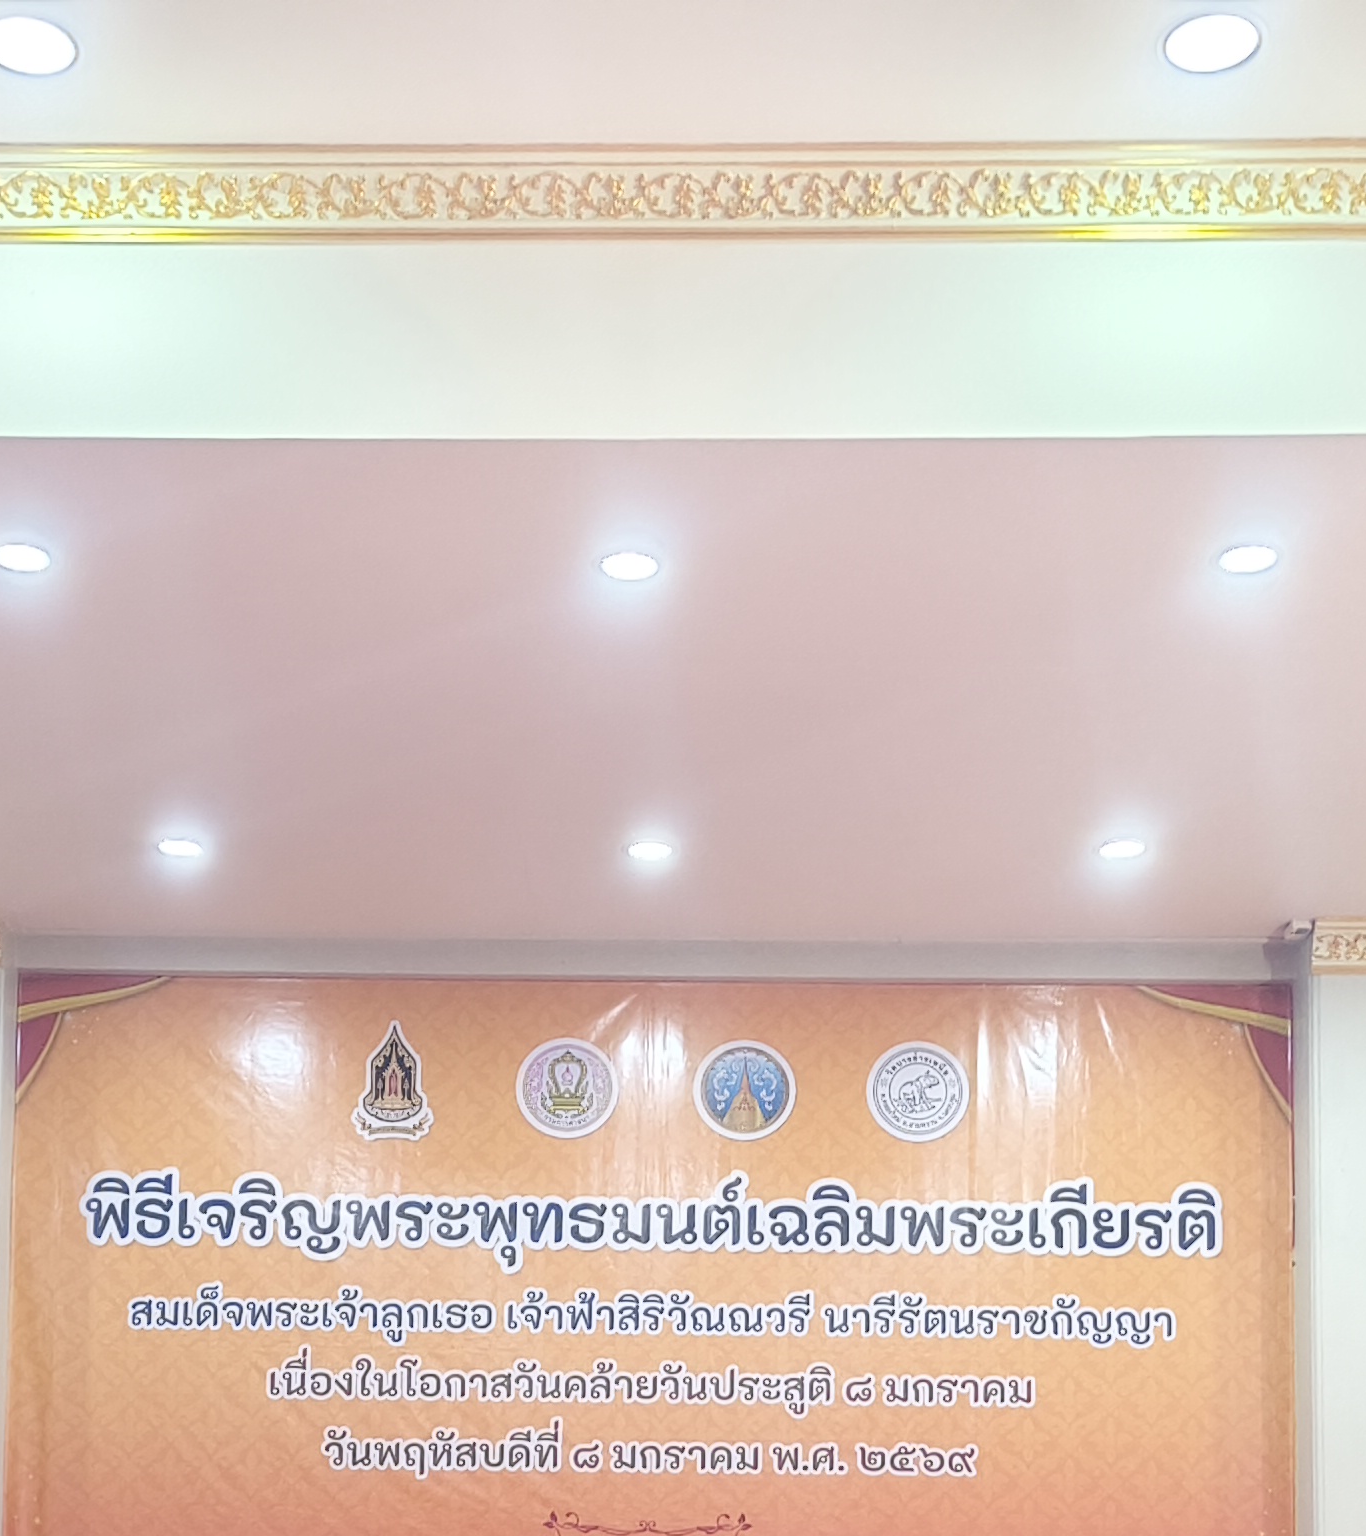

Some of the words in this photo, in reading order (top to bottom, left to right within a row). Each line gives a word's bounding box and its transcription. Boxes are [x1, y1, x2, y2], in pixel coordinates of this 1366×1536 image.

[84, 1172, 1217, 1268] พิธีเจริญพระพุทธมนต์เฉลิมพระเกียรติ
[131, 1284, 493, 1341] สมเด็จพระเจ้าลูกเธอ
[506, 1290, 811, 1333] เจ้าฟ้าสิริวัณณวรี
[823, 1293, 1173, 1345] นารีรัตนราชกัญญา
[269, 1350, 832, 1416] เนื่องในโอกาสวันคล้ายวันประสูติ
[845, 1376, 873, 1403] ๘
[884, 1377, 1032, 1405] มกราคม
[323, 1419, 560, 1477] วันพฤหัสบดีที่
[572, 1442, 601, 1470] ๘
[611, 1443, 760, 1472] มกราคม
[771, 1444, 846, 1473] พ.ศ.
[858, 1444, 976, 1474] ๒๕๖๙
